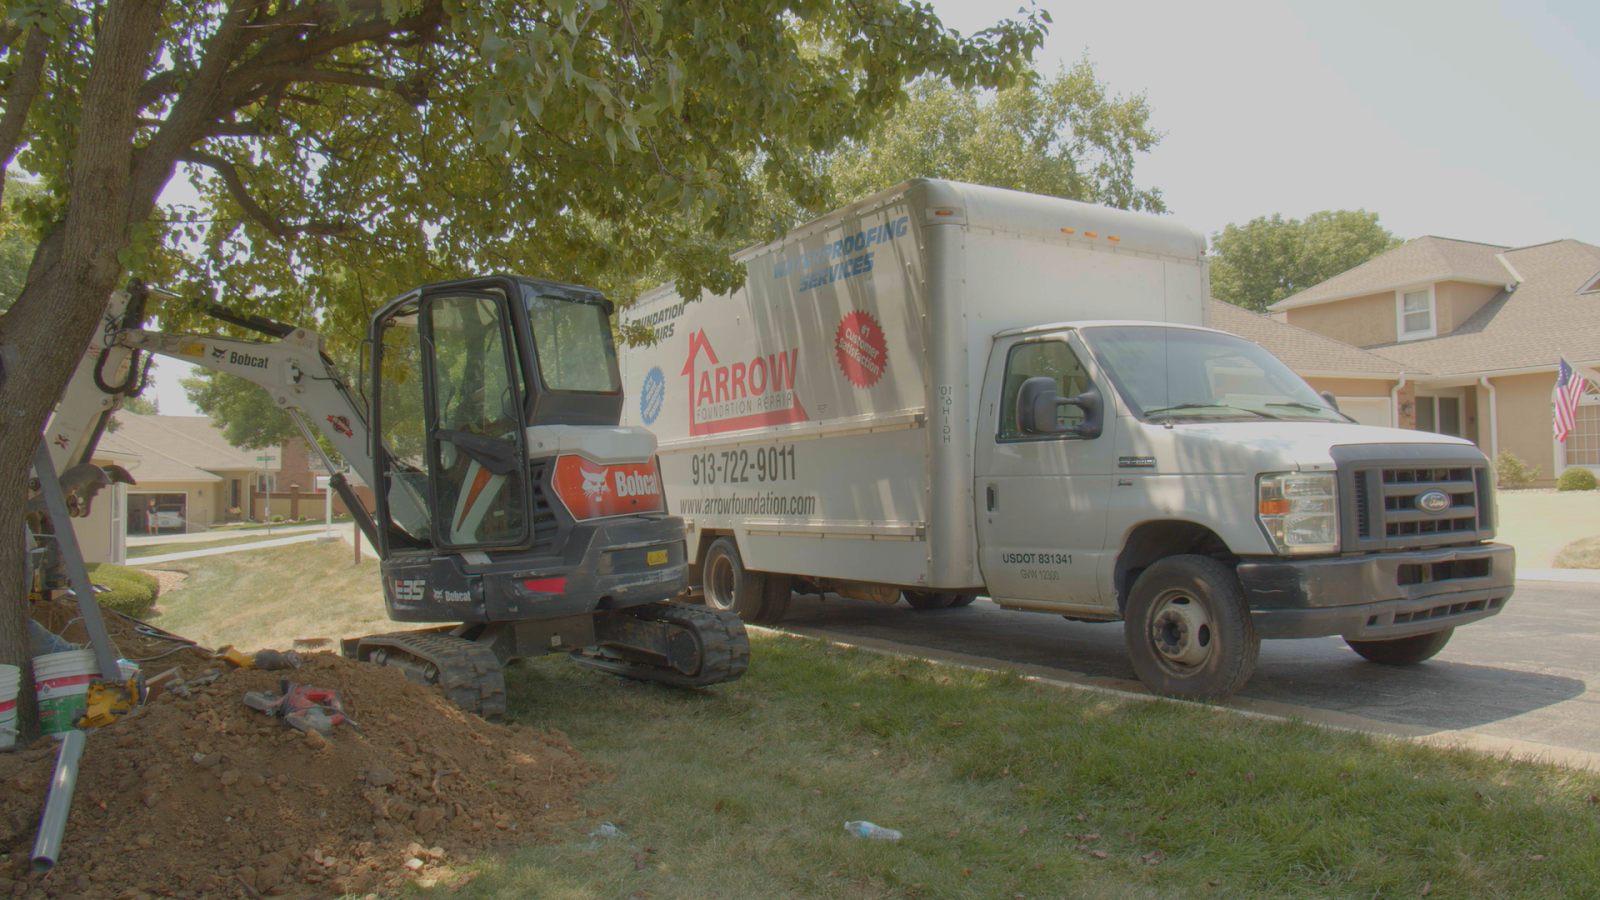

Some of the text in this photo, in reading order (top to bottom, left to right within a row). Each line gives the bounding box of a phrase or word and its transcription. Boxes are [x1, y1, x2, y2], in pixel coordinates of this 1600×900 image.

[772, 215, 909, 280] WATERPROOFING
[798, 251, 875, 293] SERVICES
[845, 327, 879, 359] Customer
[860, 324, 871, 339] #1
[229, 351, 269, 369] Bobcat
[696, 348, 798, 407] ARROW
[697, 392, 792, 421] FOUNDATION REPAIR
[692, 444, 796, 485] 913-722-9011
[614, 470, 659, 497] Bobcat
[680, 491, 816, 515] www.arrowfoundation.com
[1002, 553, 1073, 565] USDOT 831341
[394, 579, 426, 601] E35
[444, 590, 472, 602] Bobcat
